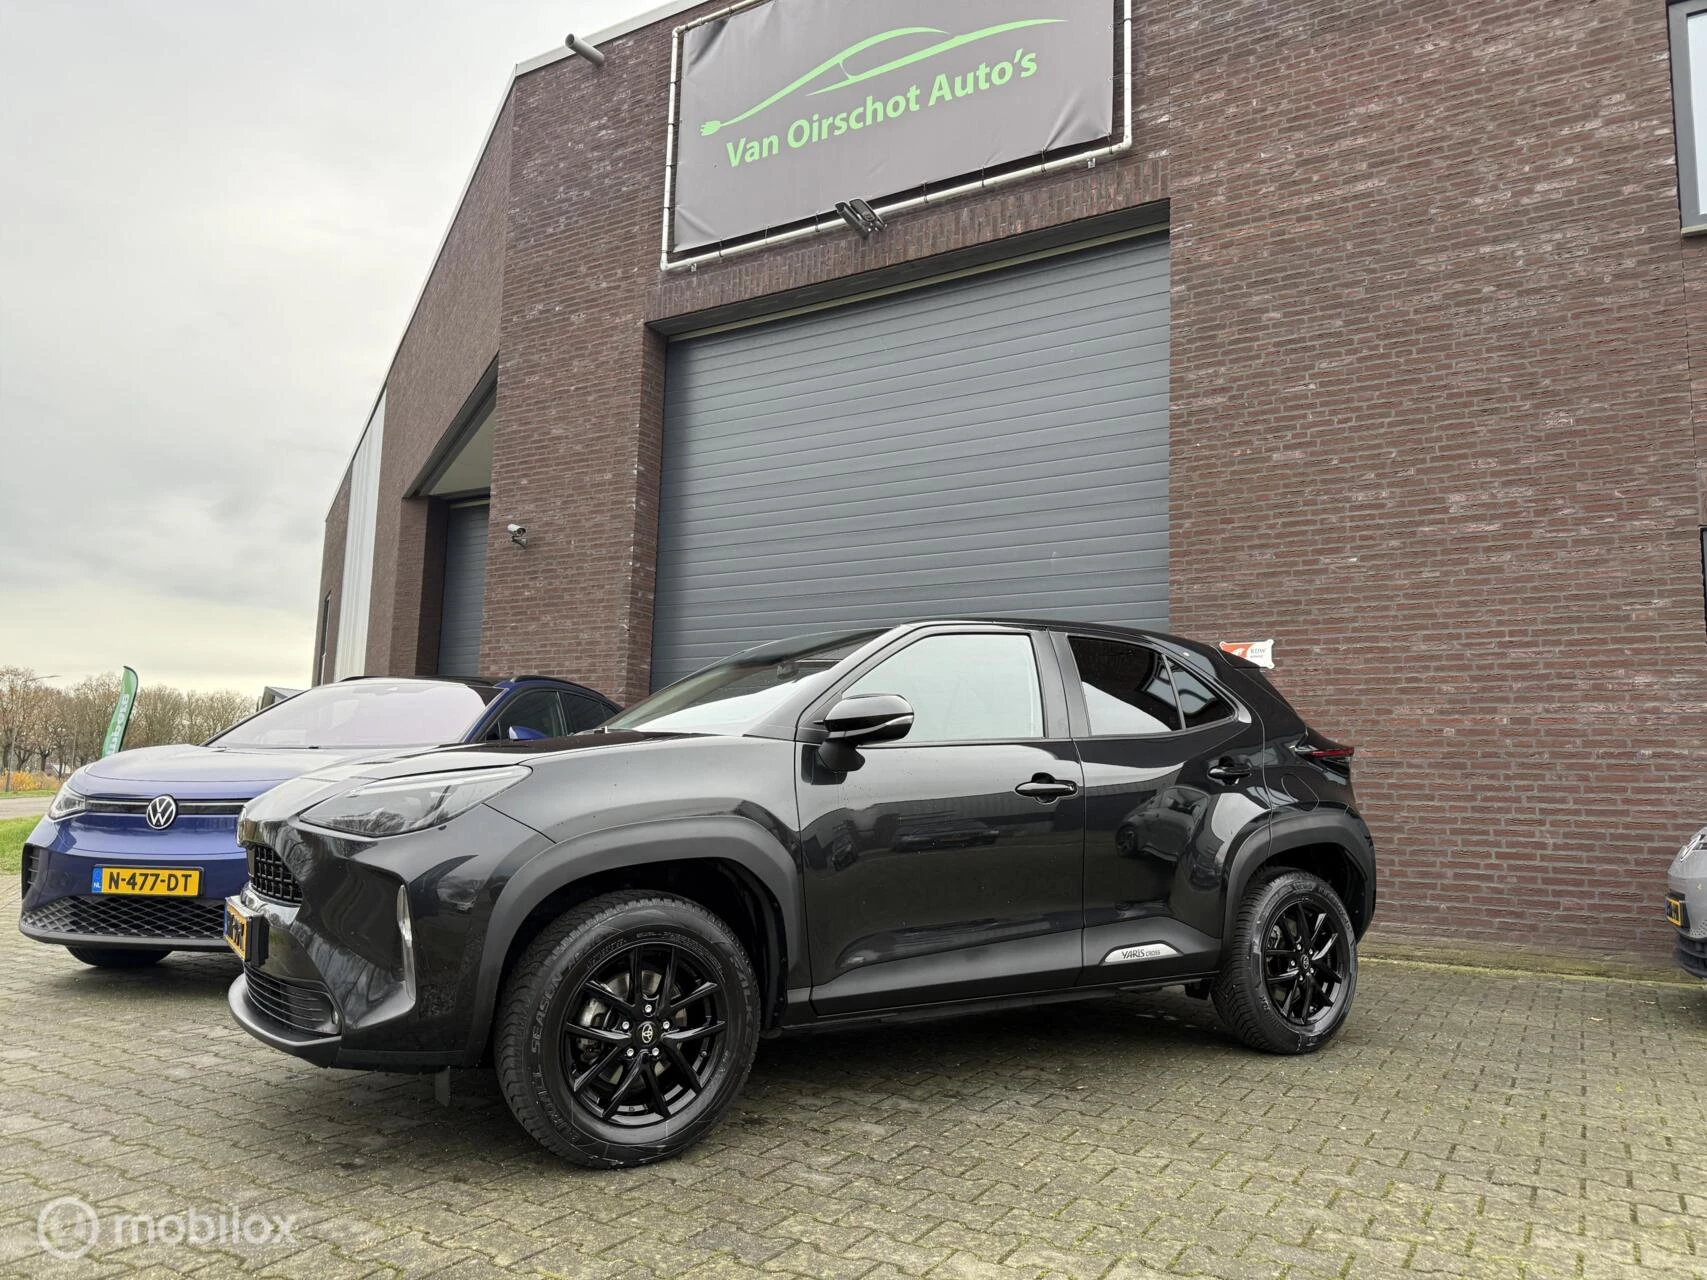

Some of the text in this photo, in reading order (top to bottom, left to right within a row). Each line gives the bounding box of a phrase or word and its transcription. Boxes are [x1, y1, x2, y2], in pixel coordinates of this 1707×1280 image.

[726, 48, 1038, 167] Van Oirschot Auto's
[108, 871, 192, 892] N-477-DT
[1121, 948, 1145, 959] YARIS
